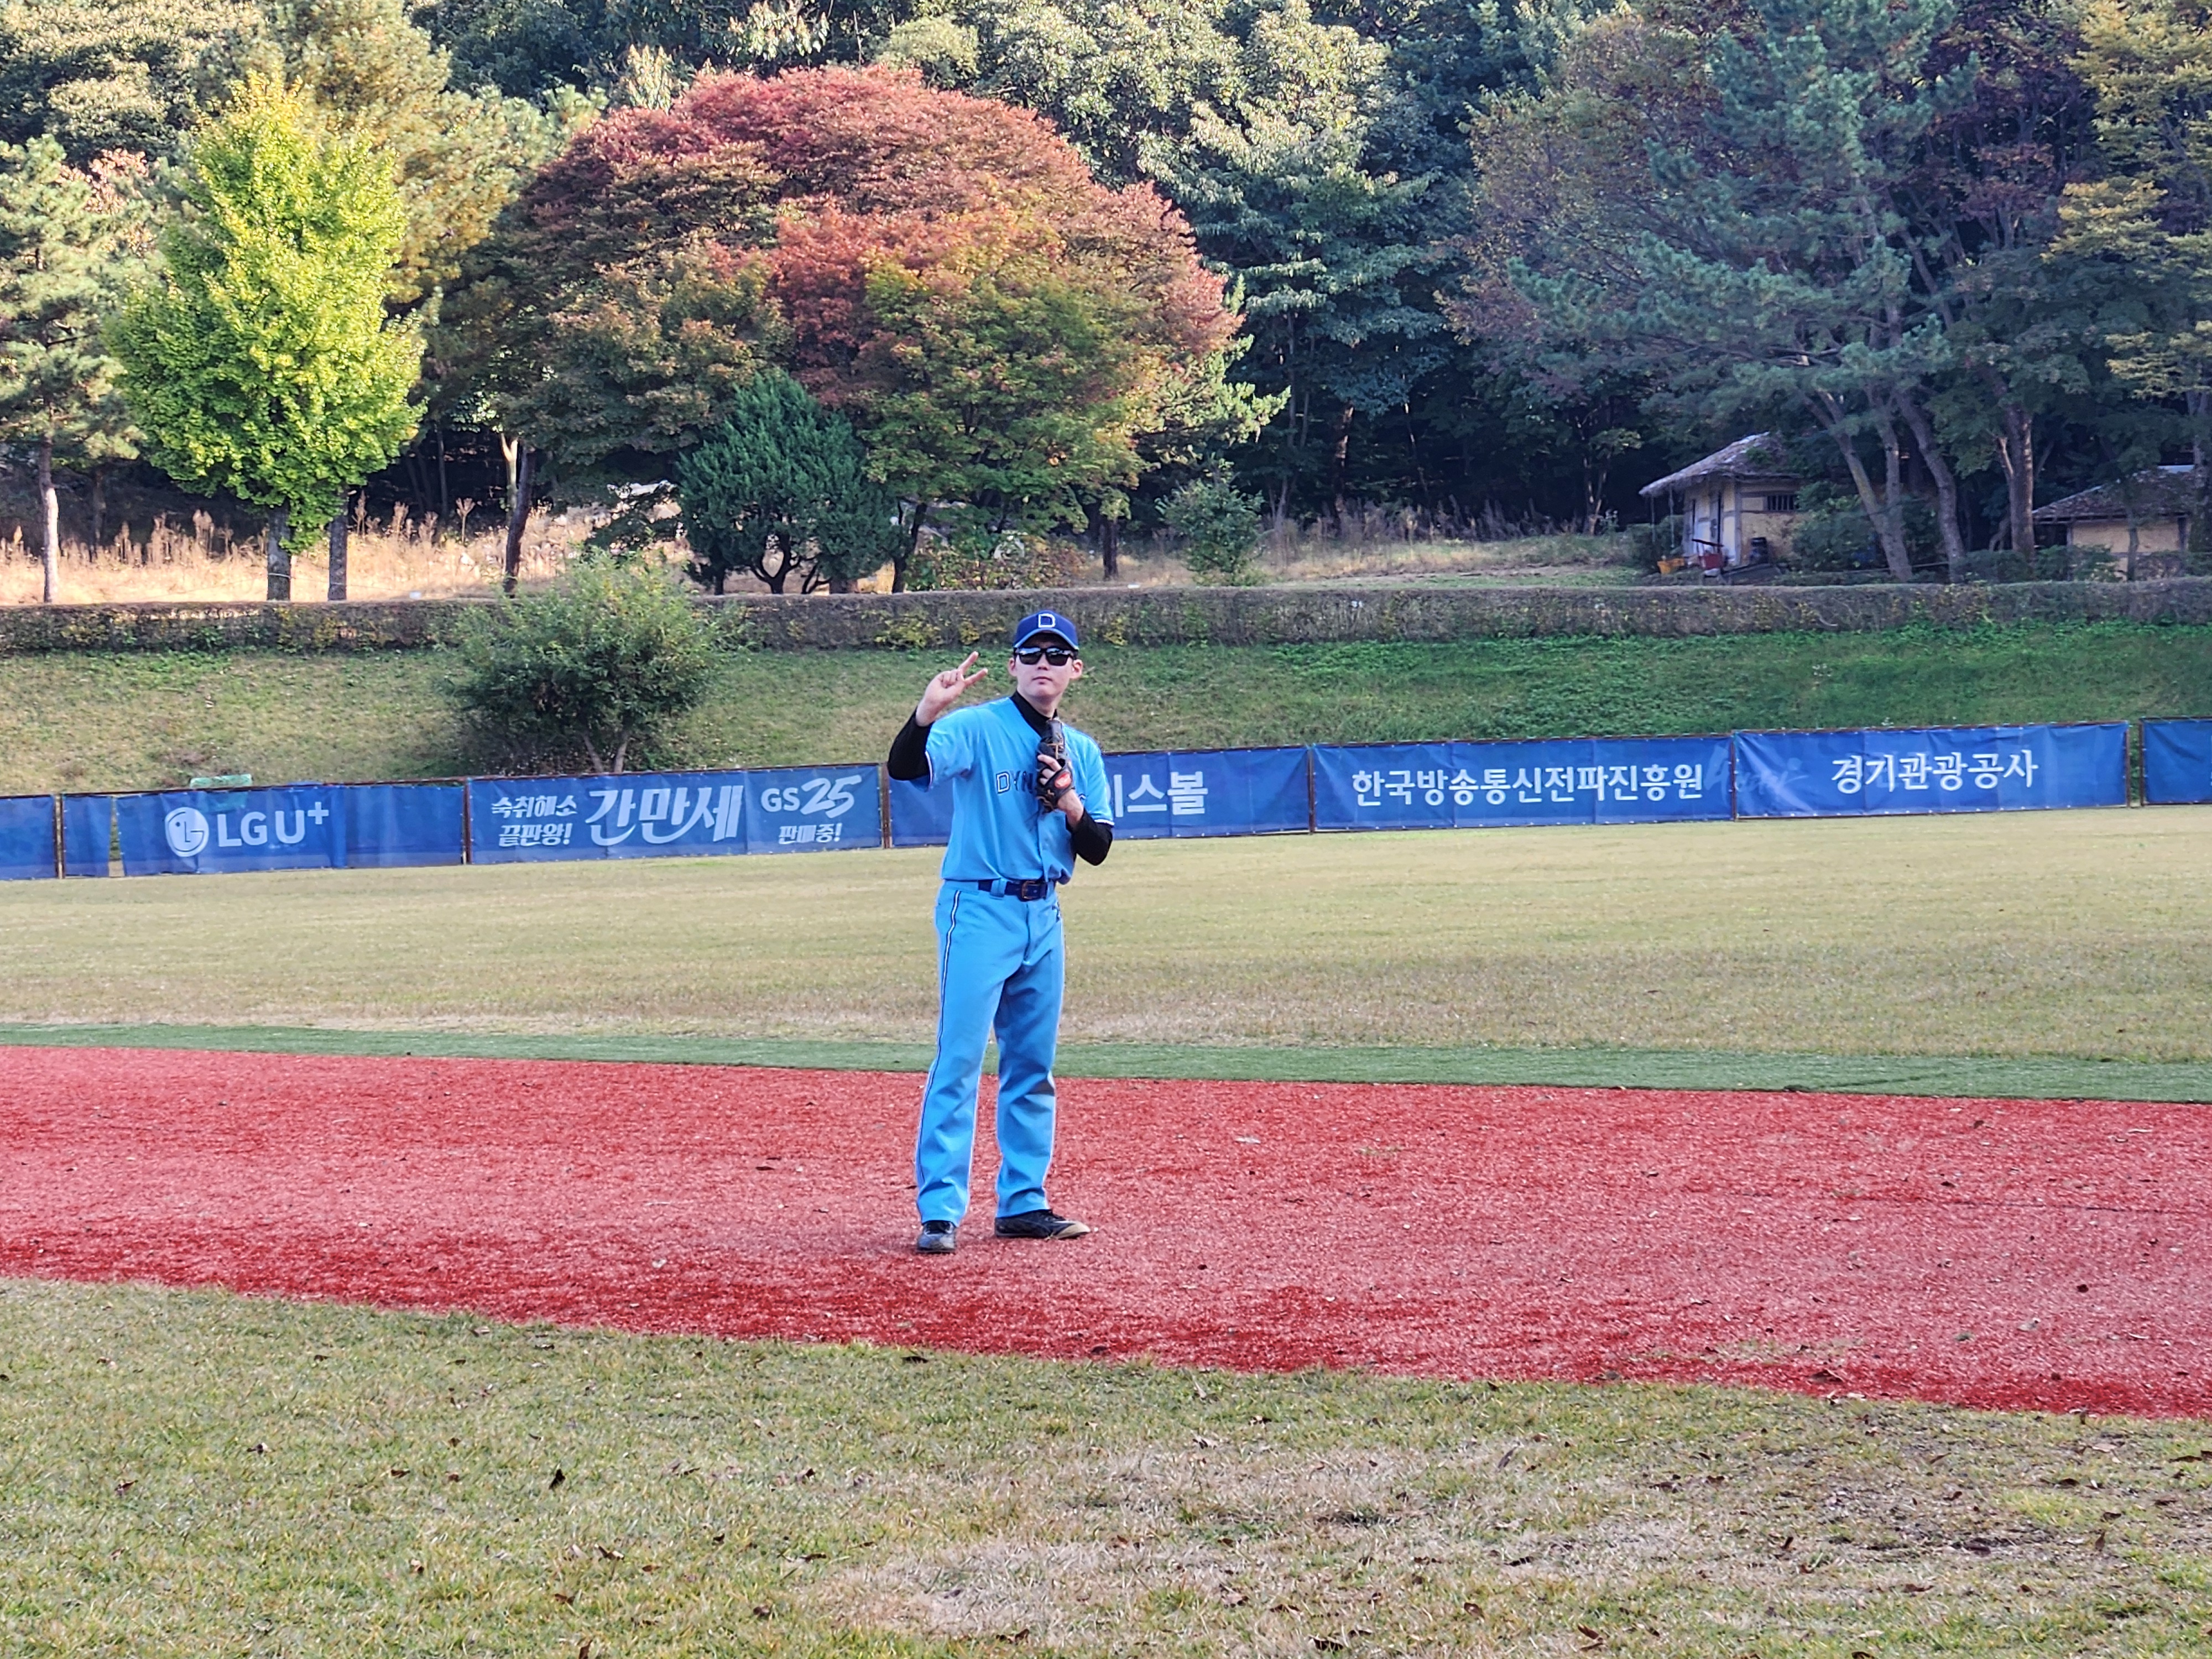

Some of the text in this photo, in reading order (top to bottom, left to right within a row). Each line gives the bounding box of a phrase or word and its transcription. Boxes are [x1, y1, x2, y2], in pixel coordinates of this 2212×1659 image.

[1038, 613, 1056, 628] D
[1352, 763, 1703, 806] 한국방송통신전파진흥원
[1832, 749, 2038, 794] 경기관광공사
[491, 795, 578, 818] 숙취해소
[585, 785, 744, 846] 간만세
[761, 775, 862, 818] GS25
[1105, 771, 1208, 817] 이스볼
[499, 823, 573, 847] 끝판왕!
[779, 822, 843, 844] 판매중!
